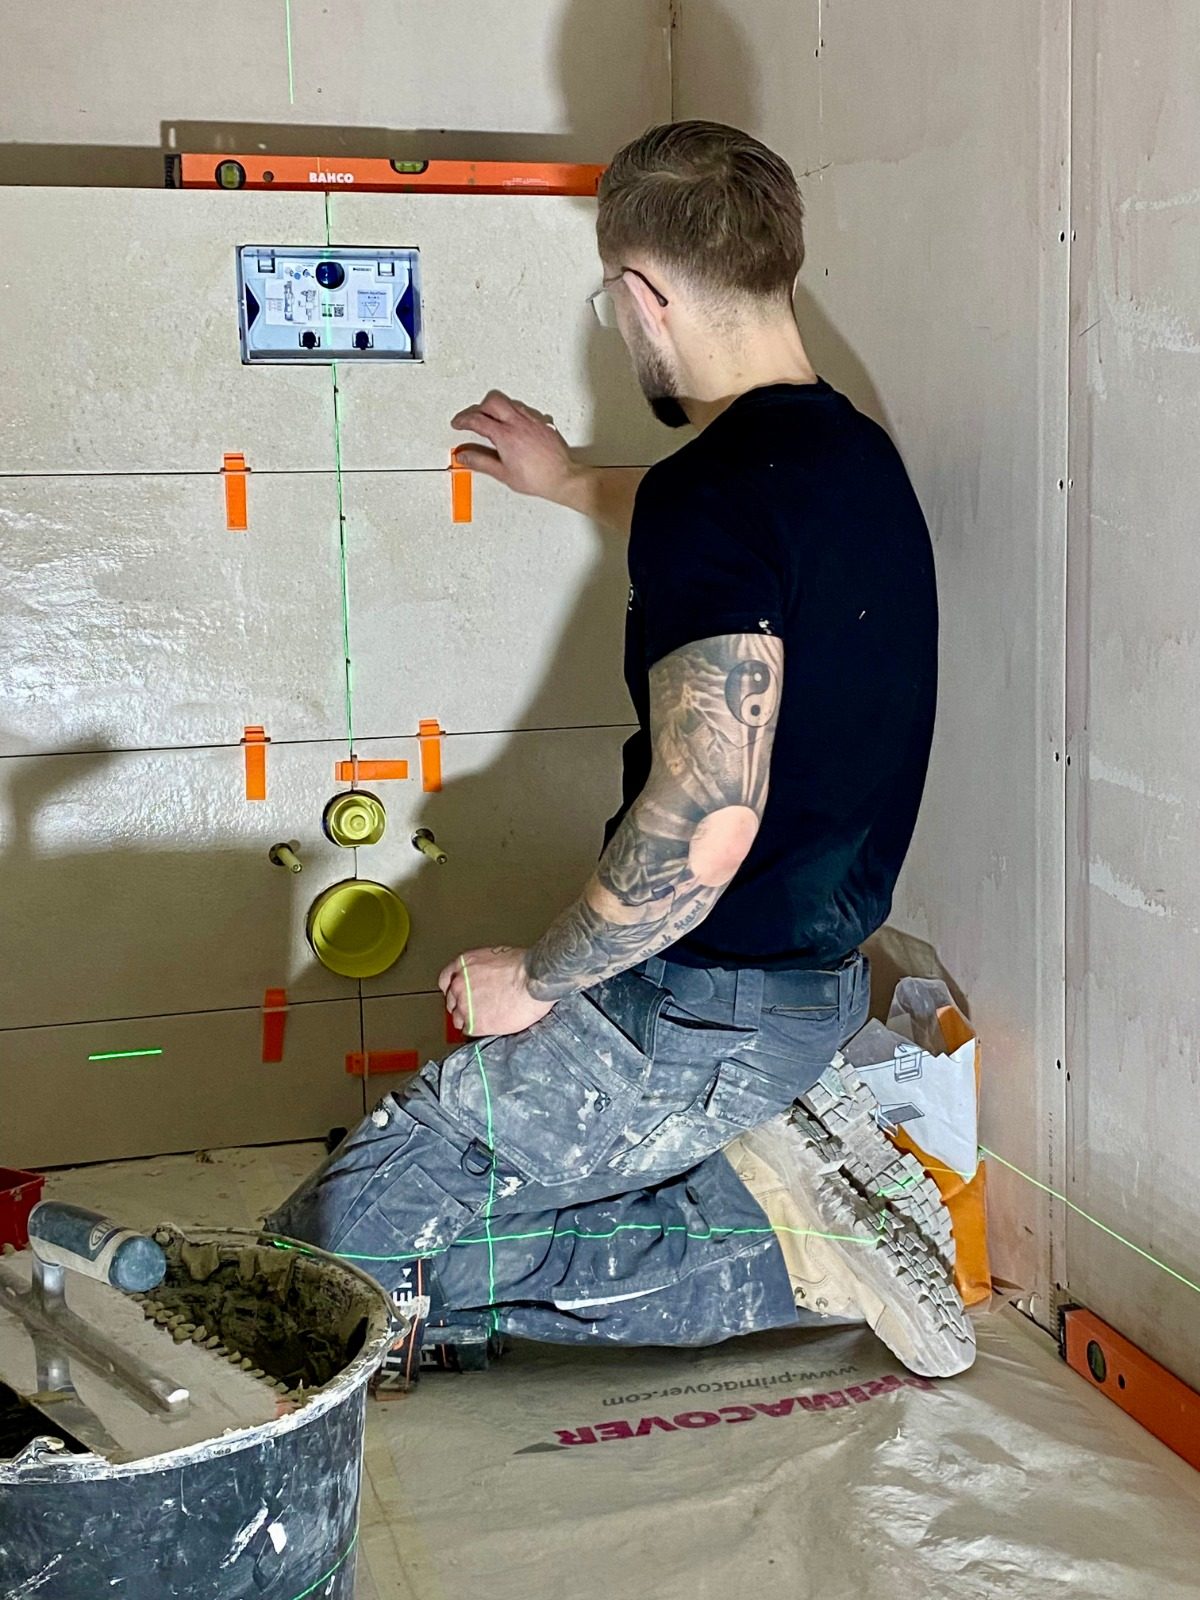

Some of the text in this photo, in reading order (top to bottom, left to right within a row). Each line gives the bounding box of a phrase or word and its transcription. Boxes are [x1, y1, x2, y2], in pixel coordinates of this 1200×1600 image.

[309, 172, 354, 184] BAHCO
[602, 1365, 859, 1407] www.primacover.com
[553, 1374, 938, 1446] PRIMACOVER
